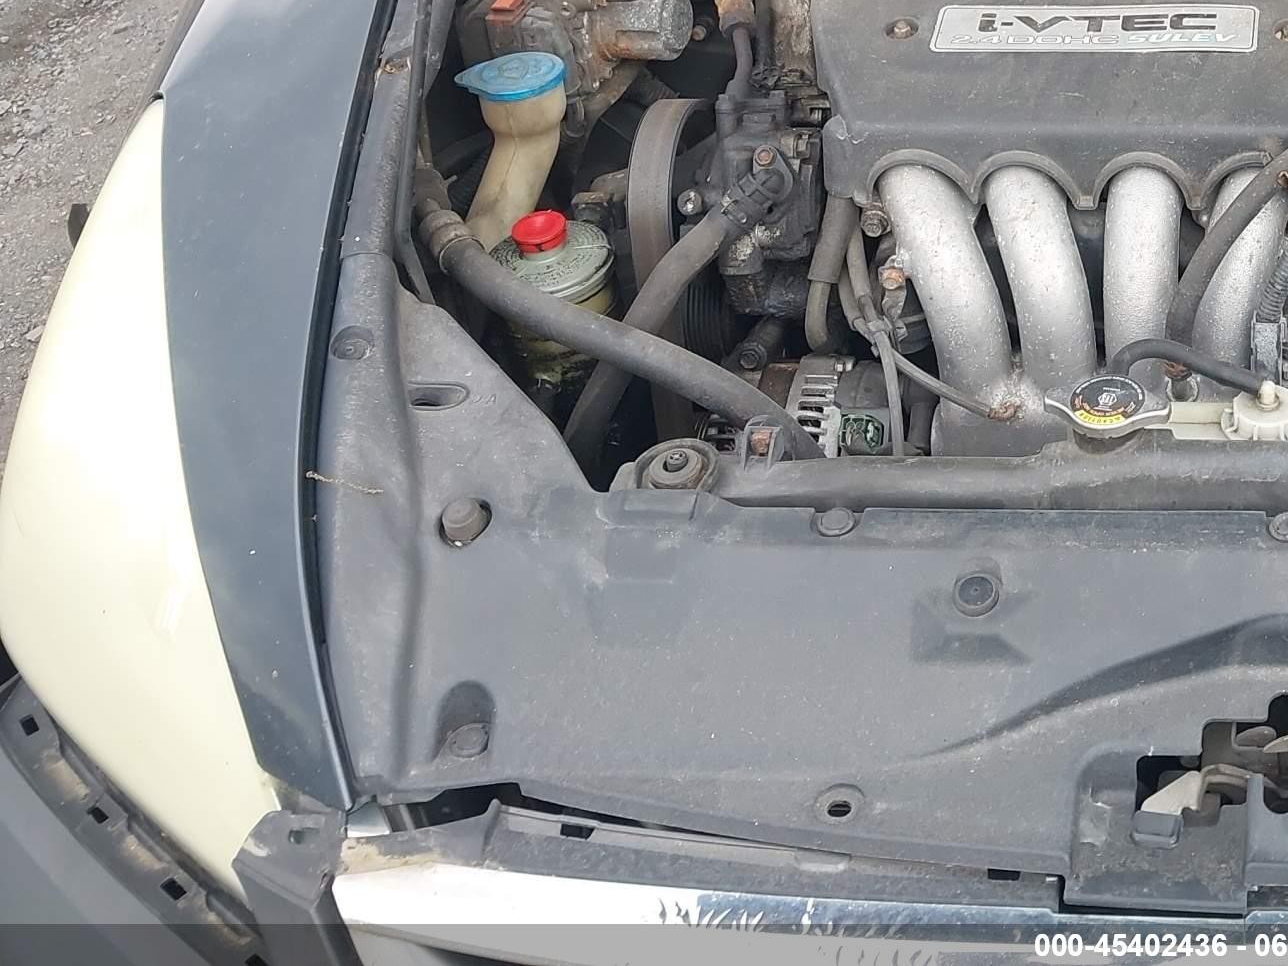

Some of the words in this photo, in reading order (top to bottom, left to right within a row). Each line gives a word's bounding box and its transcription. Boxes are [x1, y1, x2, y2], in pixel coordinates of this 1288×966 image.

[978, 13, 1218, 33] i-VTEC
[950, 34, 1003, 45] 2.4
[1006, 34, 1119, 45] DOHC
[1128, 33, 1239, 44] SULEV
